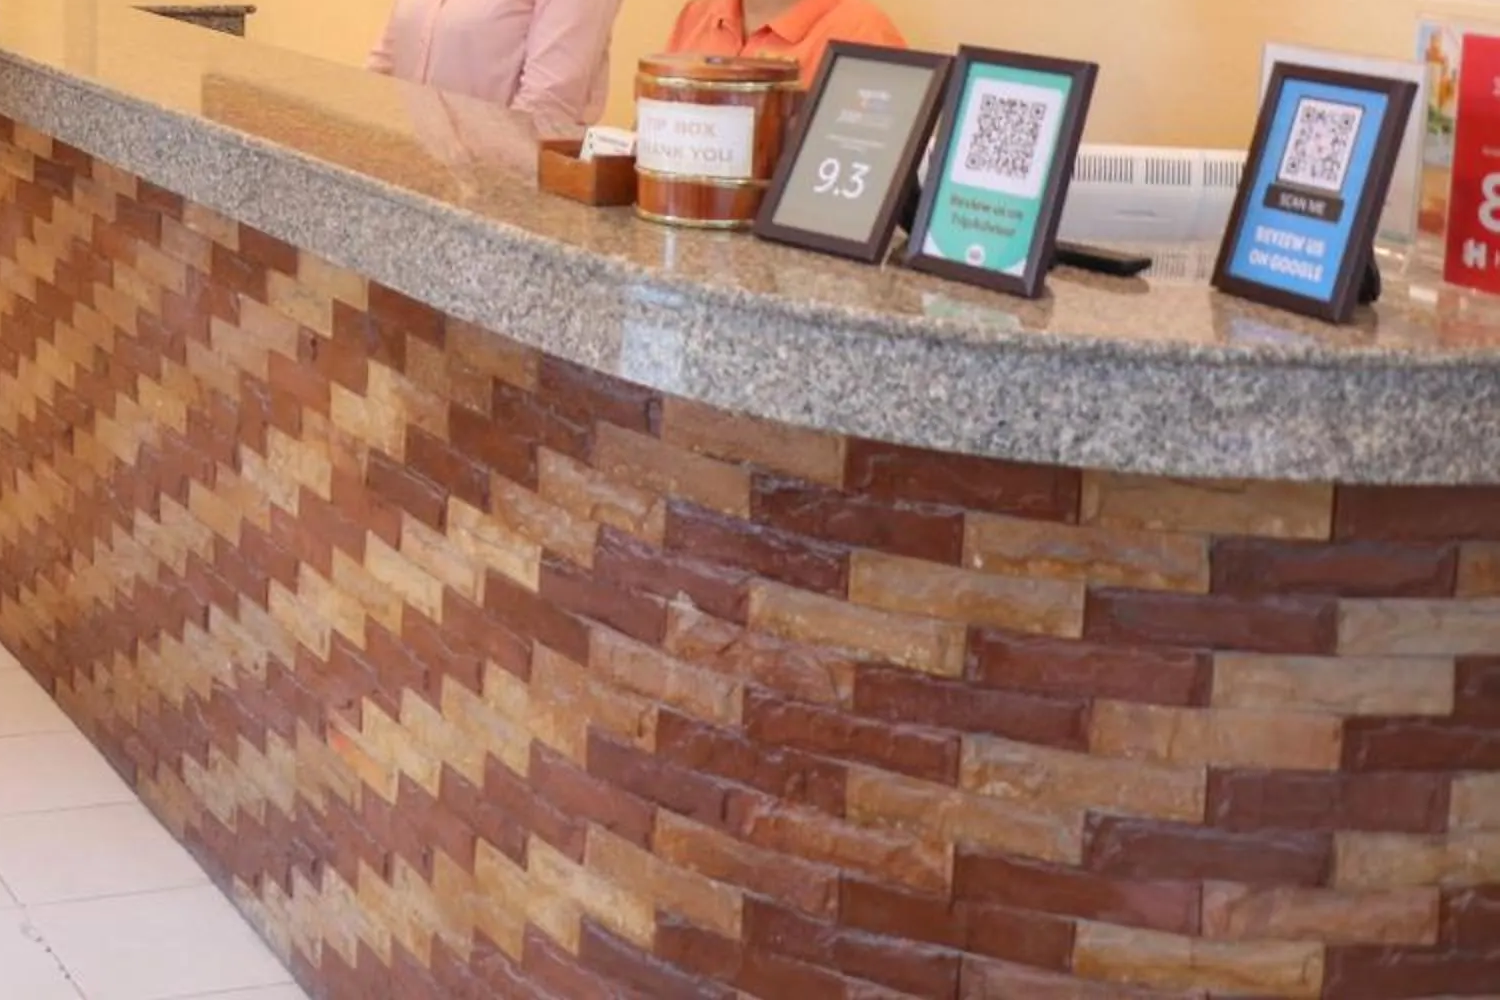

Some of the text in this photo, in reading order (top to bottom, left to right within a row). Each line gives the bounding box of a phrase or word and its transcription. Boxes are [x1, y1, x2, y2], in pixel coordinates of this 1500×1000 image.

[673, 118, 718, 138] BOX
[640, 141, 684, 160] HANK
[690, 145, 734, 163] YOU
[812, 157, 872, 199] 9.3
[1278, 191, 1327, 216] SCAN ME
[1254, 224, 1326, 258] REVIEW US
[1248, 247, 1325, 284] ON GOOGLE
